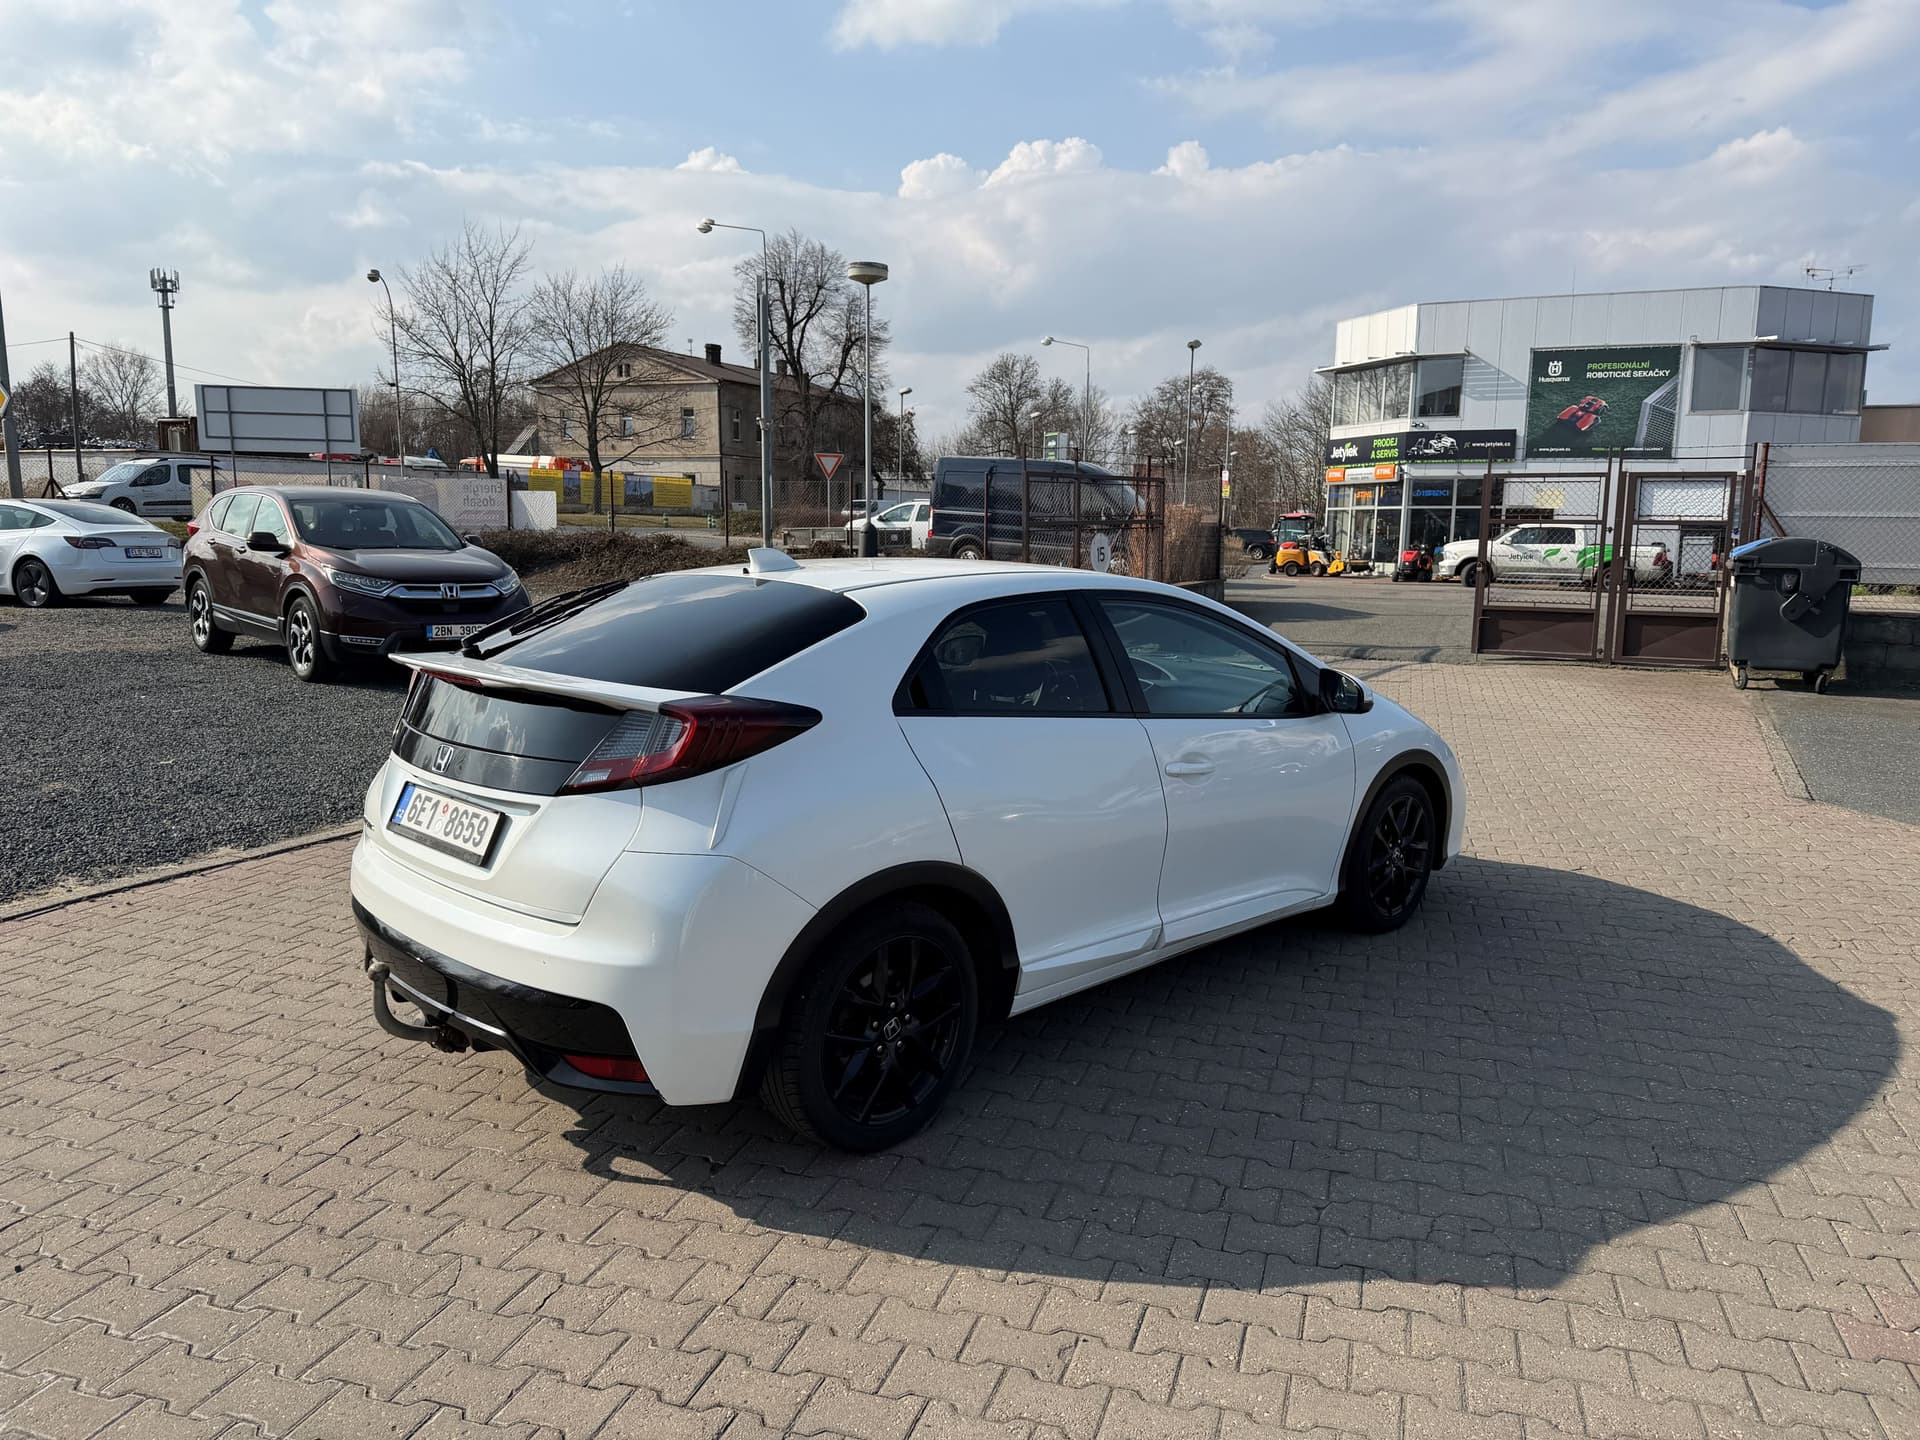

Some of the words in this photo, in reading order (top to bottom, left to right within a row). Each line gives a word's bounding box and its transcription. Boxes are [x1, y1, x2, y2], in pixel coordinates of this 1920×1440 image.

[1587, 361, 1650, 370] PROFESIONÁLNÍ
[1586, 370, 1631, 379] ROBOTICKÉ
[1632, 369, 1671, 378] SEKAČKY
[1373, 437, 1398, 448] PRODEJ
[1371, 451, 1376, 459] A
[1376, 449, 1398, 459] SERVIS
[1376, 467, 1391, 475] STIHL
[1096, 547, 1105, 562] 15
[435, 626, 453, 636] 2BN
[407, 793, 441, 830] 6E1
[443, 806, 489, 847] 8659
